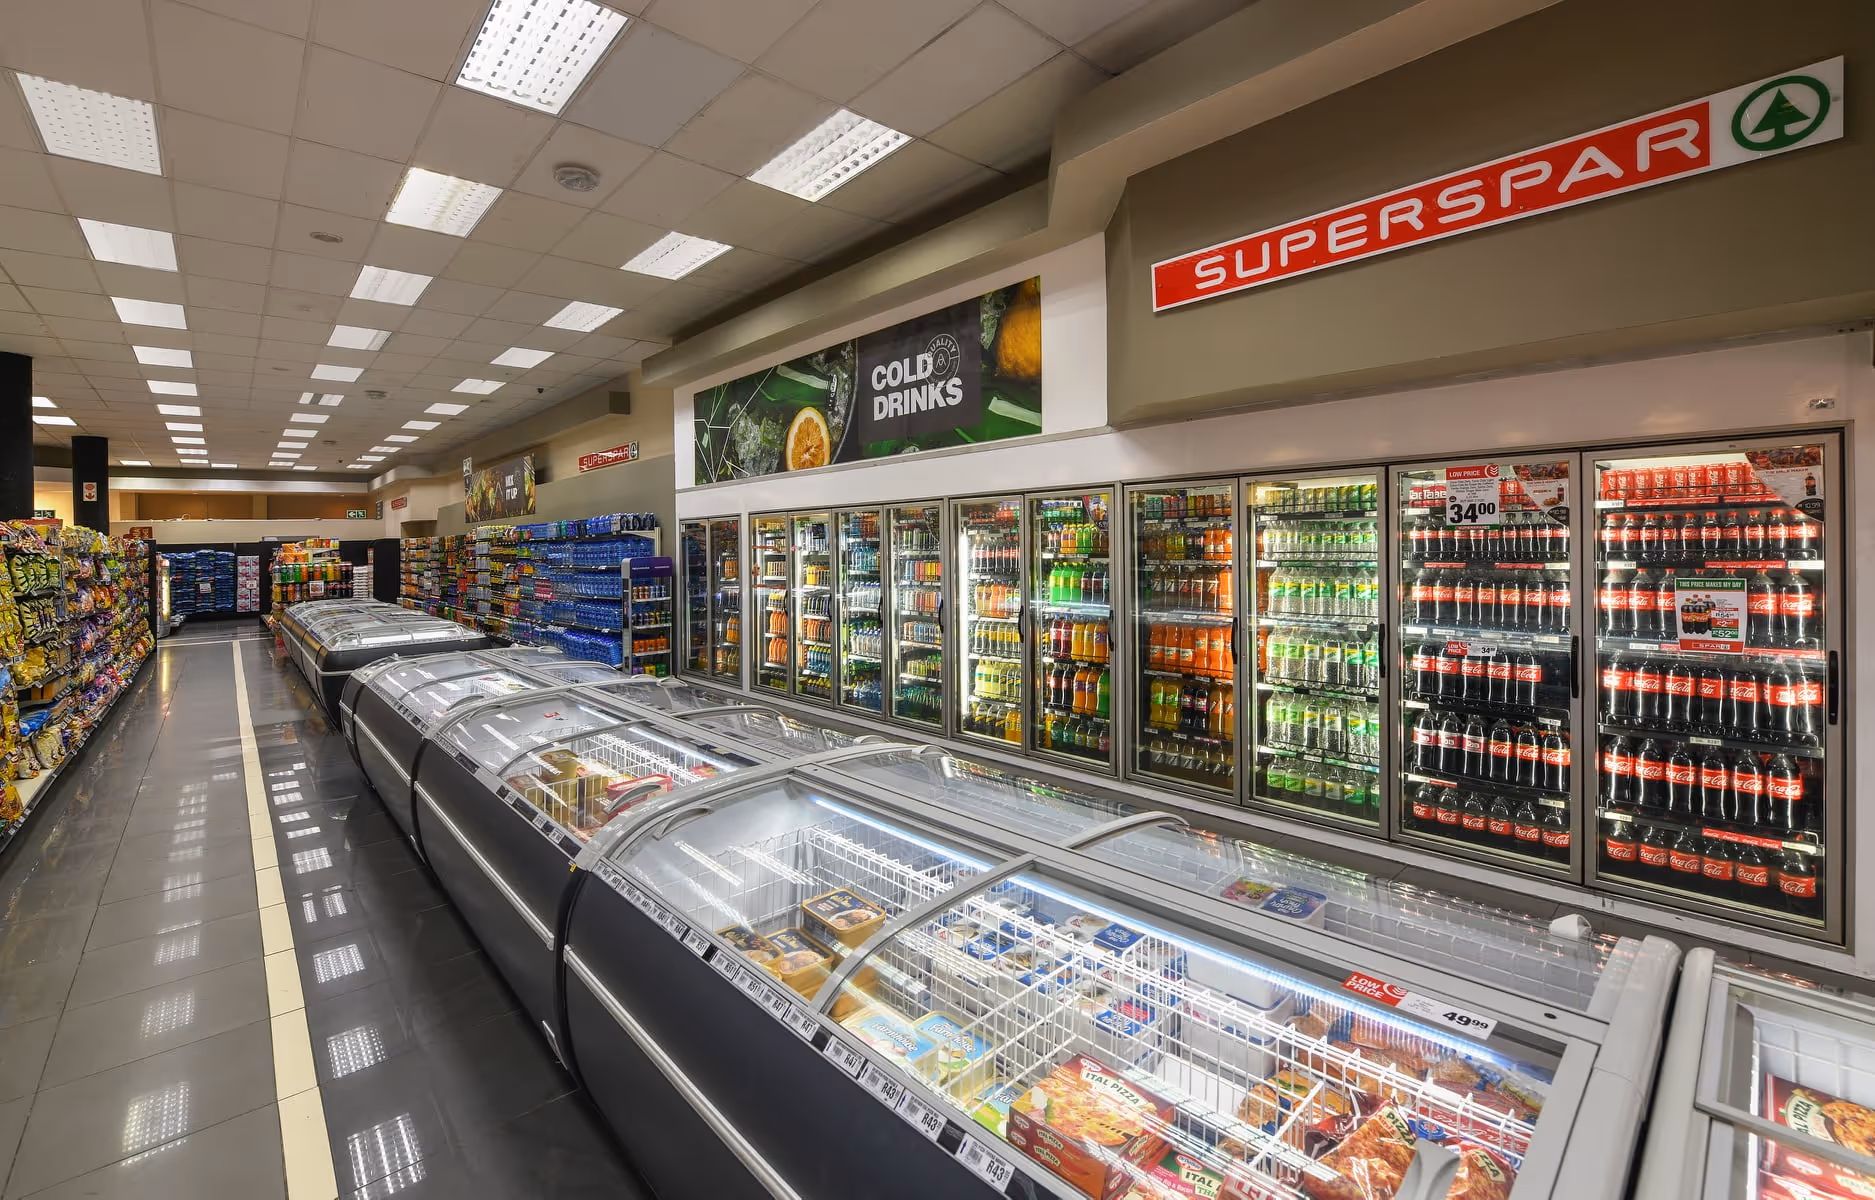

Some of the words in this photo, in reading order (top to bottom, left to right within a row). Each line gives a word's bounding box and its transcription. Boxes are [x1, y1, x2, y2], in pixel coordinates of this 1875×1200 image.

[1194, 118, 1702, 289] SUPERSPAR
[926, 338, 956, 358] QUALITY
[871, 352, 934, 391] COLD
[873, 377, 963, 421] DRINKS
[583, 446, 629, 467] SUPERSPAR
[1346, 981, 1385, 999] PRICE
[1350, 975, 1381, 989] LOW
[872, 1022, 918, 1052] Farmhouse
[843, 1053, 858, 1069] R47
[880, 1082, 897, 1099] R43
[1085, 1072, 1109, 1085] ITAL
[1110, 1082, 1140, 1105] PIZZA
[1792, 1100, 1813, 1119] PIZZA
[920, 1112, 938, 1131] R43
[1385, 1111, 1415, 1146] PIZZA
[985, 1159, 1005, 1181] R43
[1185, 1171, 1213, 1188] ITAL
